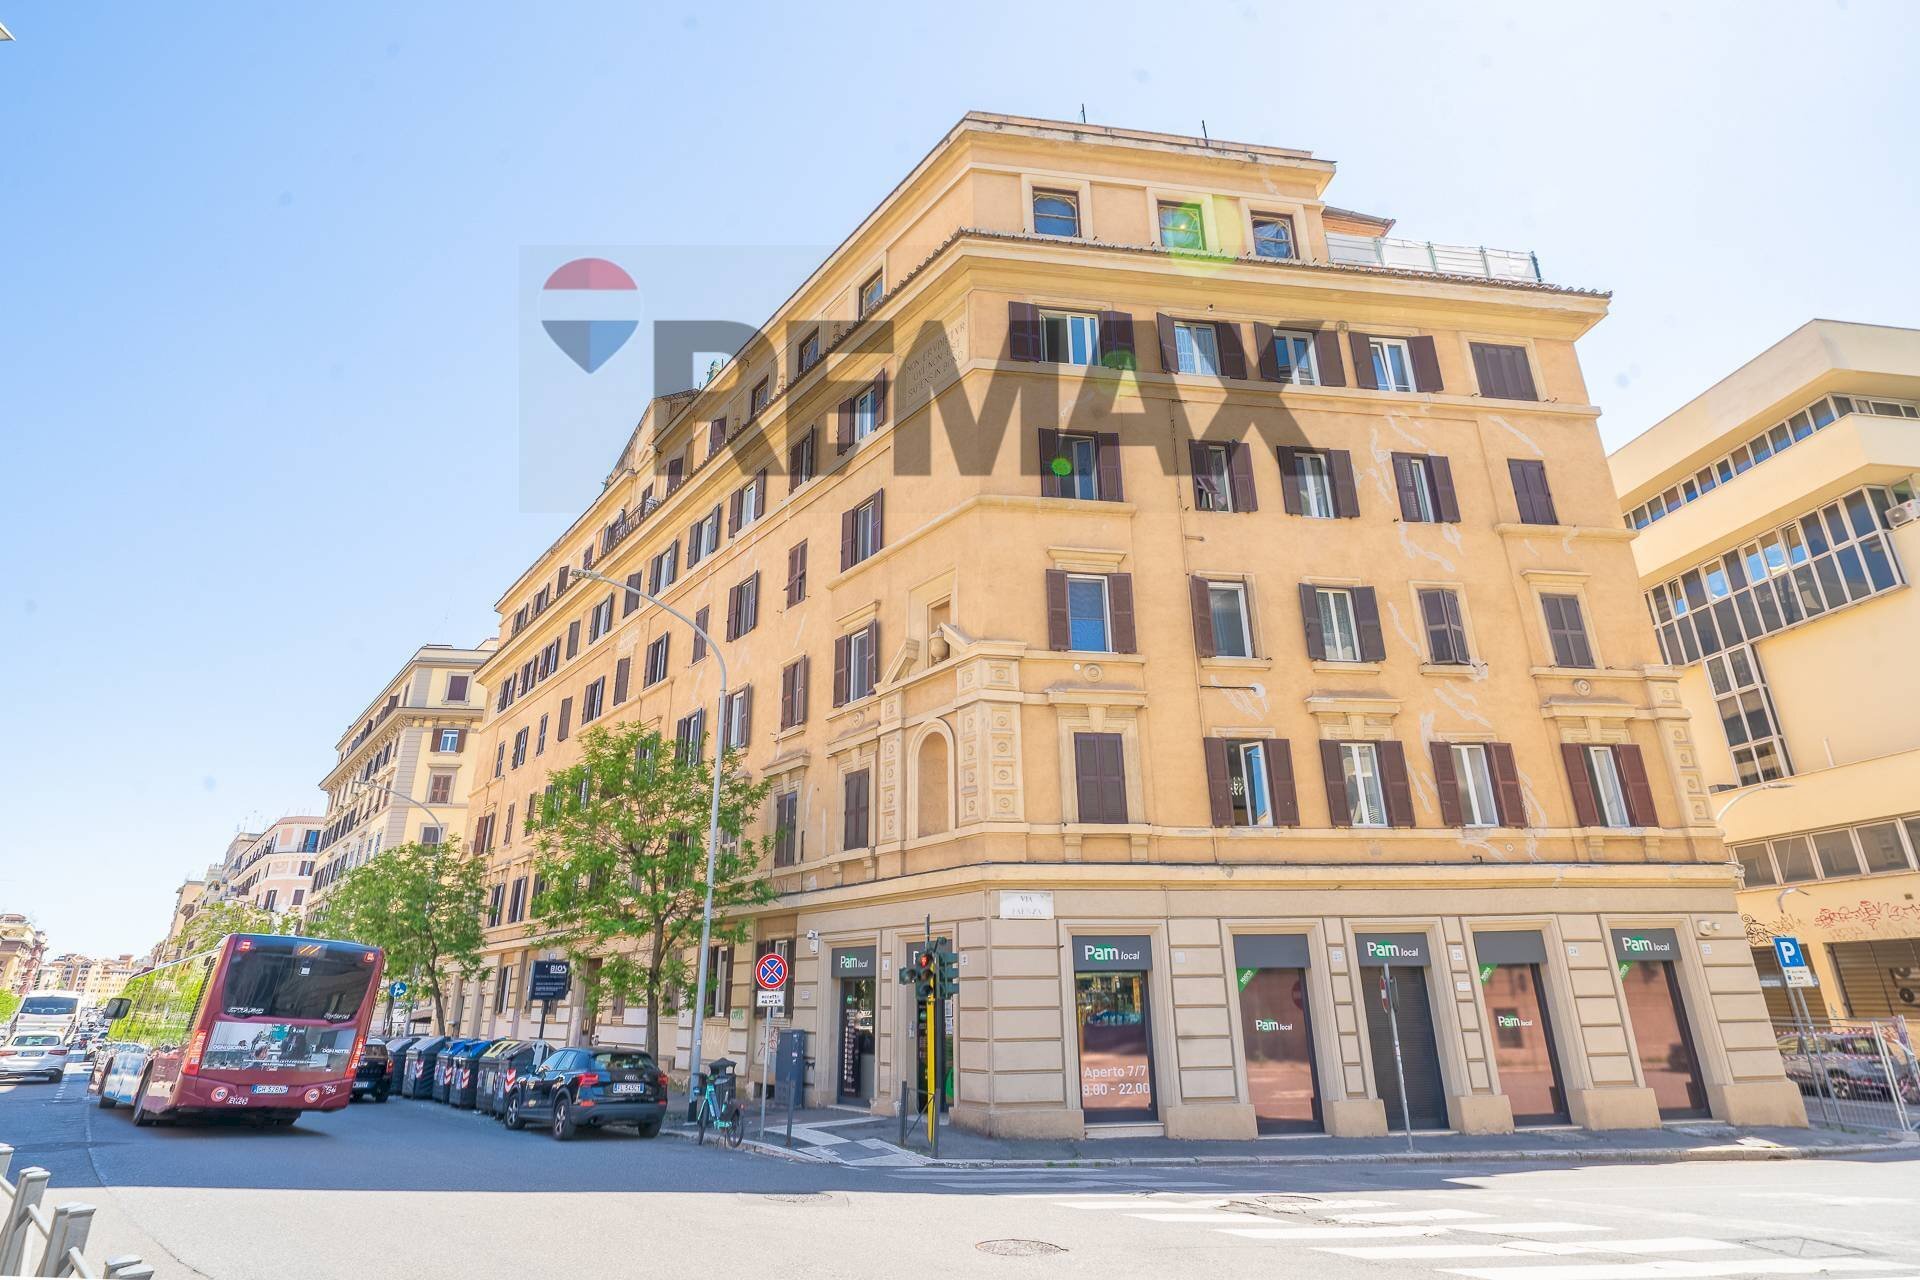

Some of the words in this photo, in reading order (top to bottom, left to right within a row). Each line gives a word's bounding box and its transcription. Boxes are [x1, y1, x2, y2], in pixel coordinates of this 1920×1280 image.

[1366, 941, 1400, 957] Pam
[1400, 948, 1419, 957] local
[1622, 937, 1653, 951] Pam
[1653, 943, 1670, 951] local
[1084, 945, 1119, 960] Pam
[1120, 951, 1140, 960] local
[1779, 941, 1796, 964] P
[550, 964, 567, 973] BIOS
[840, 955, 858, 968] Pam
[858, 959, 869, 968] local
[1255, 1020, 1279, 1031] Pam
[1498, 1016, 1520, 1027] Pam
[1084, 1066, 1125, 1079] Aperto
[1127, 1065, 1146, 1077] 7/7
[1083, 1083, 1108, 1096] 8.00
[1118, 1082, 1151, 1095] 22.00
